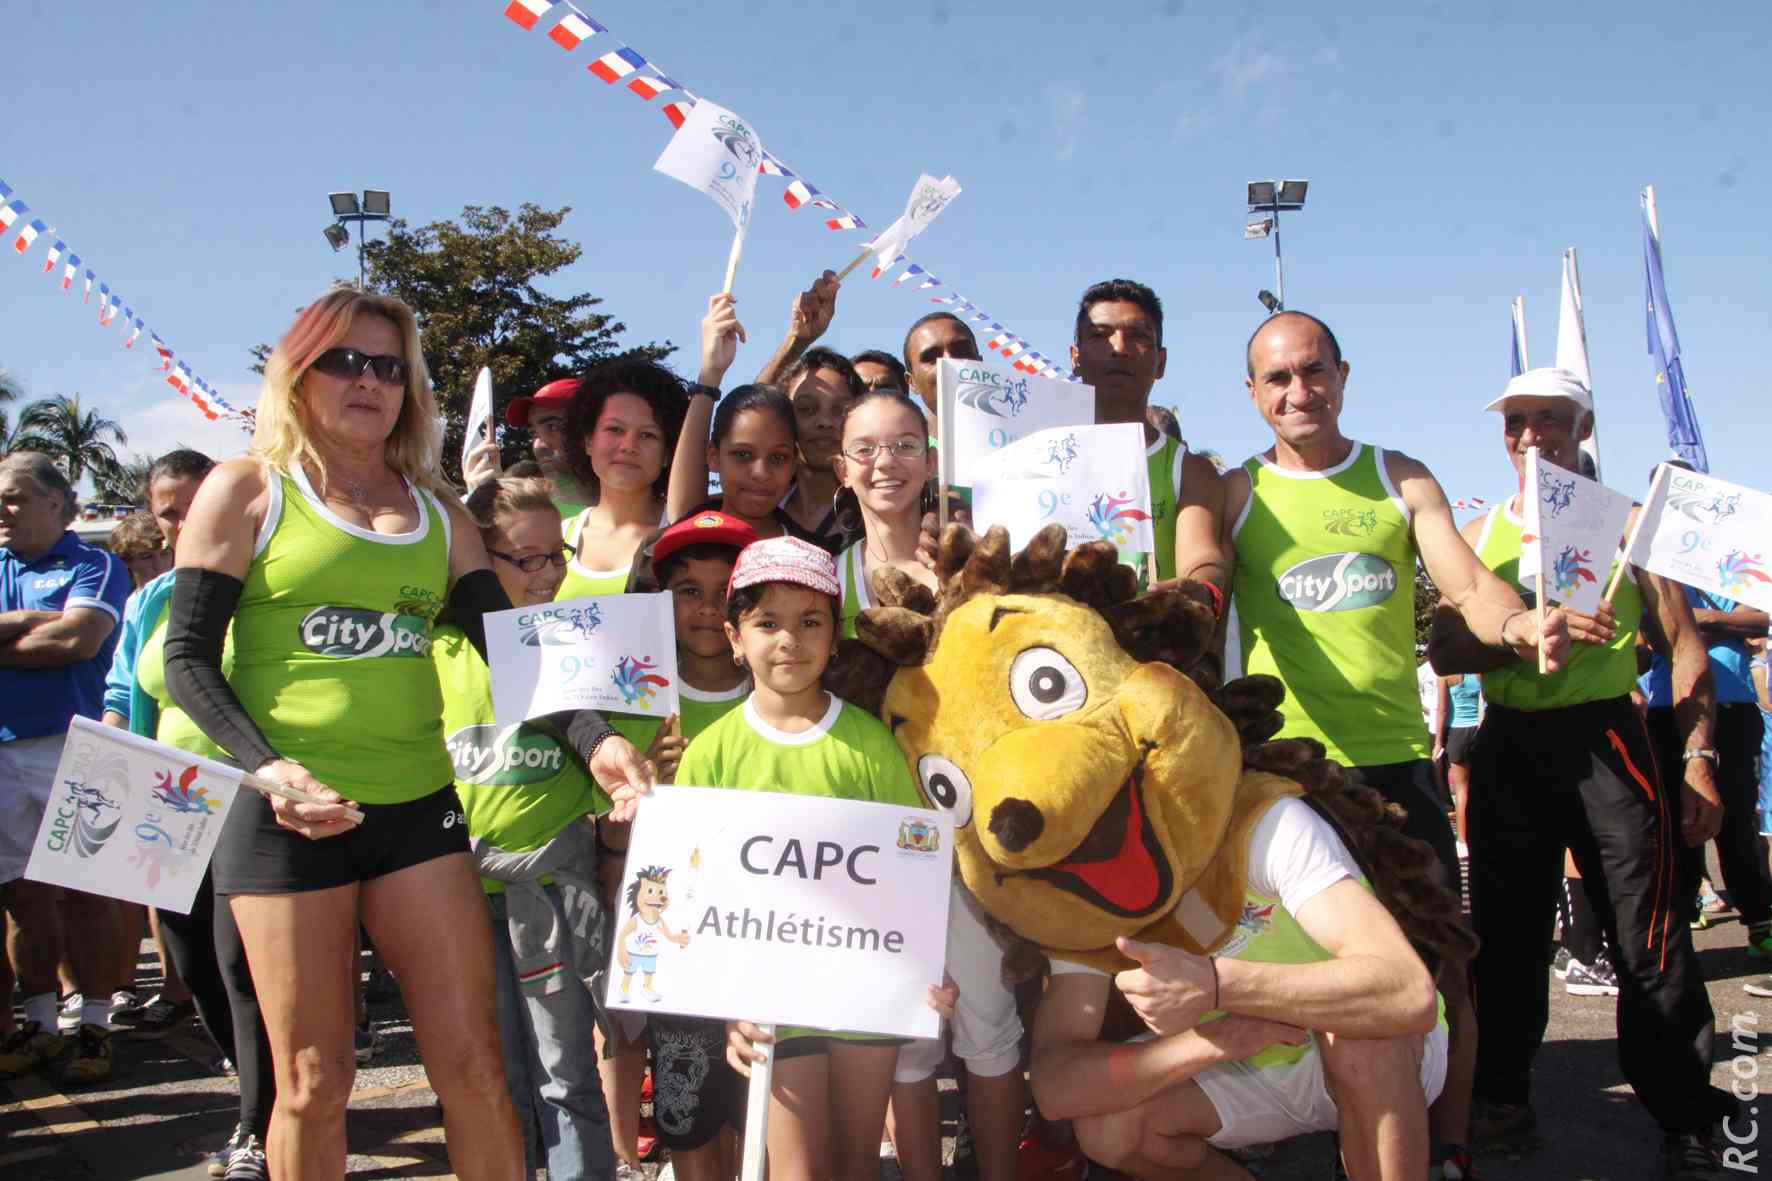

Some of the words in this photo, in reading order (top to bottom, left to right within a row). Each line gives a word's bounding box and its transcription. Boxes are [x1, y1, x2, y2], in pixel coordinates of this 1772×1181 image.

[958, 366, 1001, 386] CAPC
[517, 607, 569, 627] CAPC
[47, 806, 75, 853] CAPC
[739, 834, 882, 886] CAPC
[696, 904, 906, 955] Athlétisme
